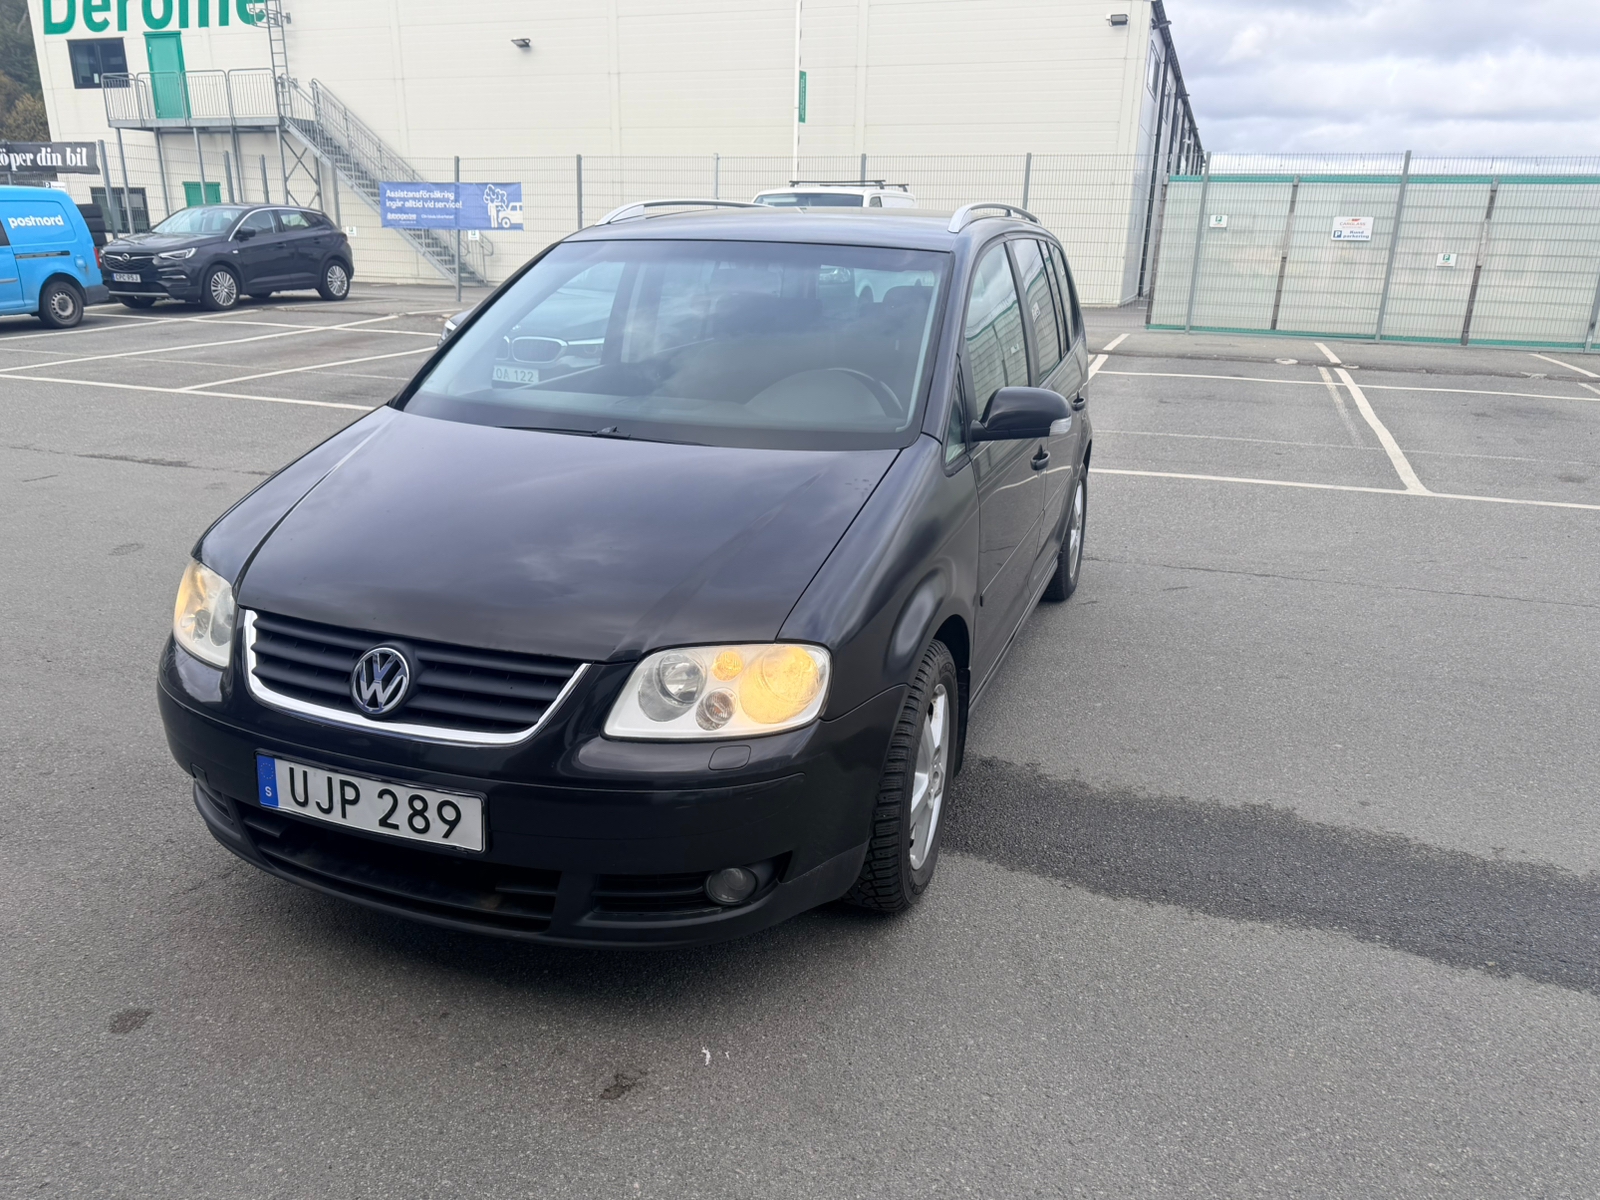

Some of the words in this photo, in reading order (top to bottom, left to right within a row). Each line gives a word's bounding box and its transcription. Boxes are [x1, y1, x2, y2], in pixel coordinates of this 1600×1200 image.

[0, 147, 34, 171] öper
[36, 147, 62, 166] din
[66, 147, 88, 167] bil
[386, 190, 455, 200] Assistansförsäkring
[386, 199, 403, 209] ingår
[405, 200, 423, 208] alltid
[424, 200, 434, 208] vid
[435, 200, 462, 209] service!
[8, 214, 64, 229] postnord
[514, 369, 534, 382] 122
[265, 786, 273, 797] S
[289, 766, 360, 819] UJP
[377, 788, 462, 839] 289
